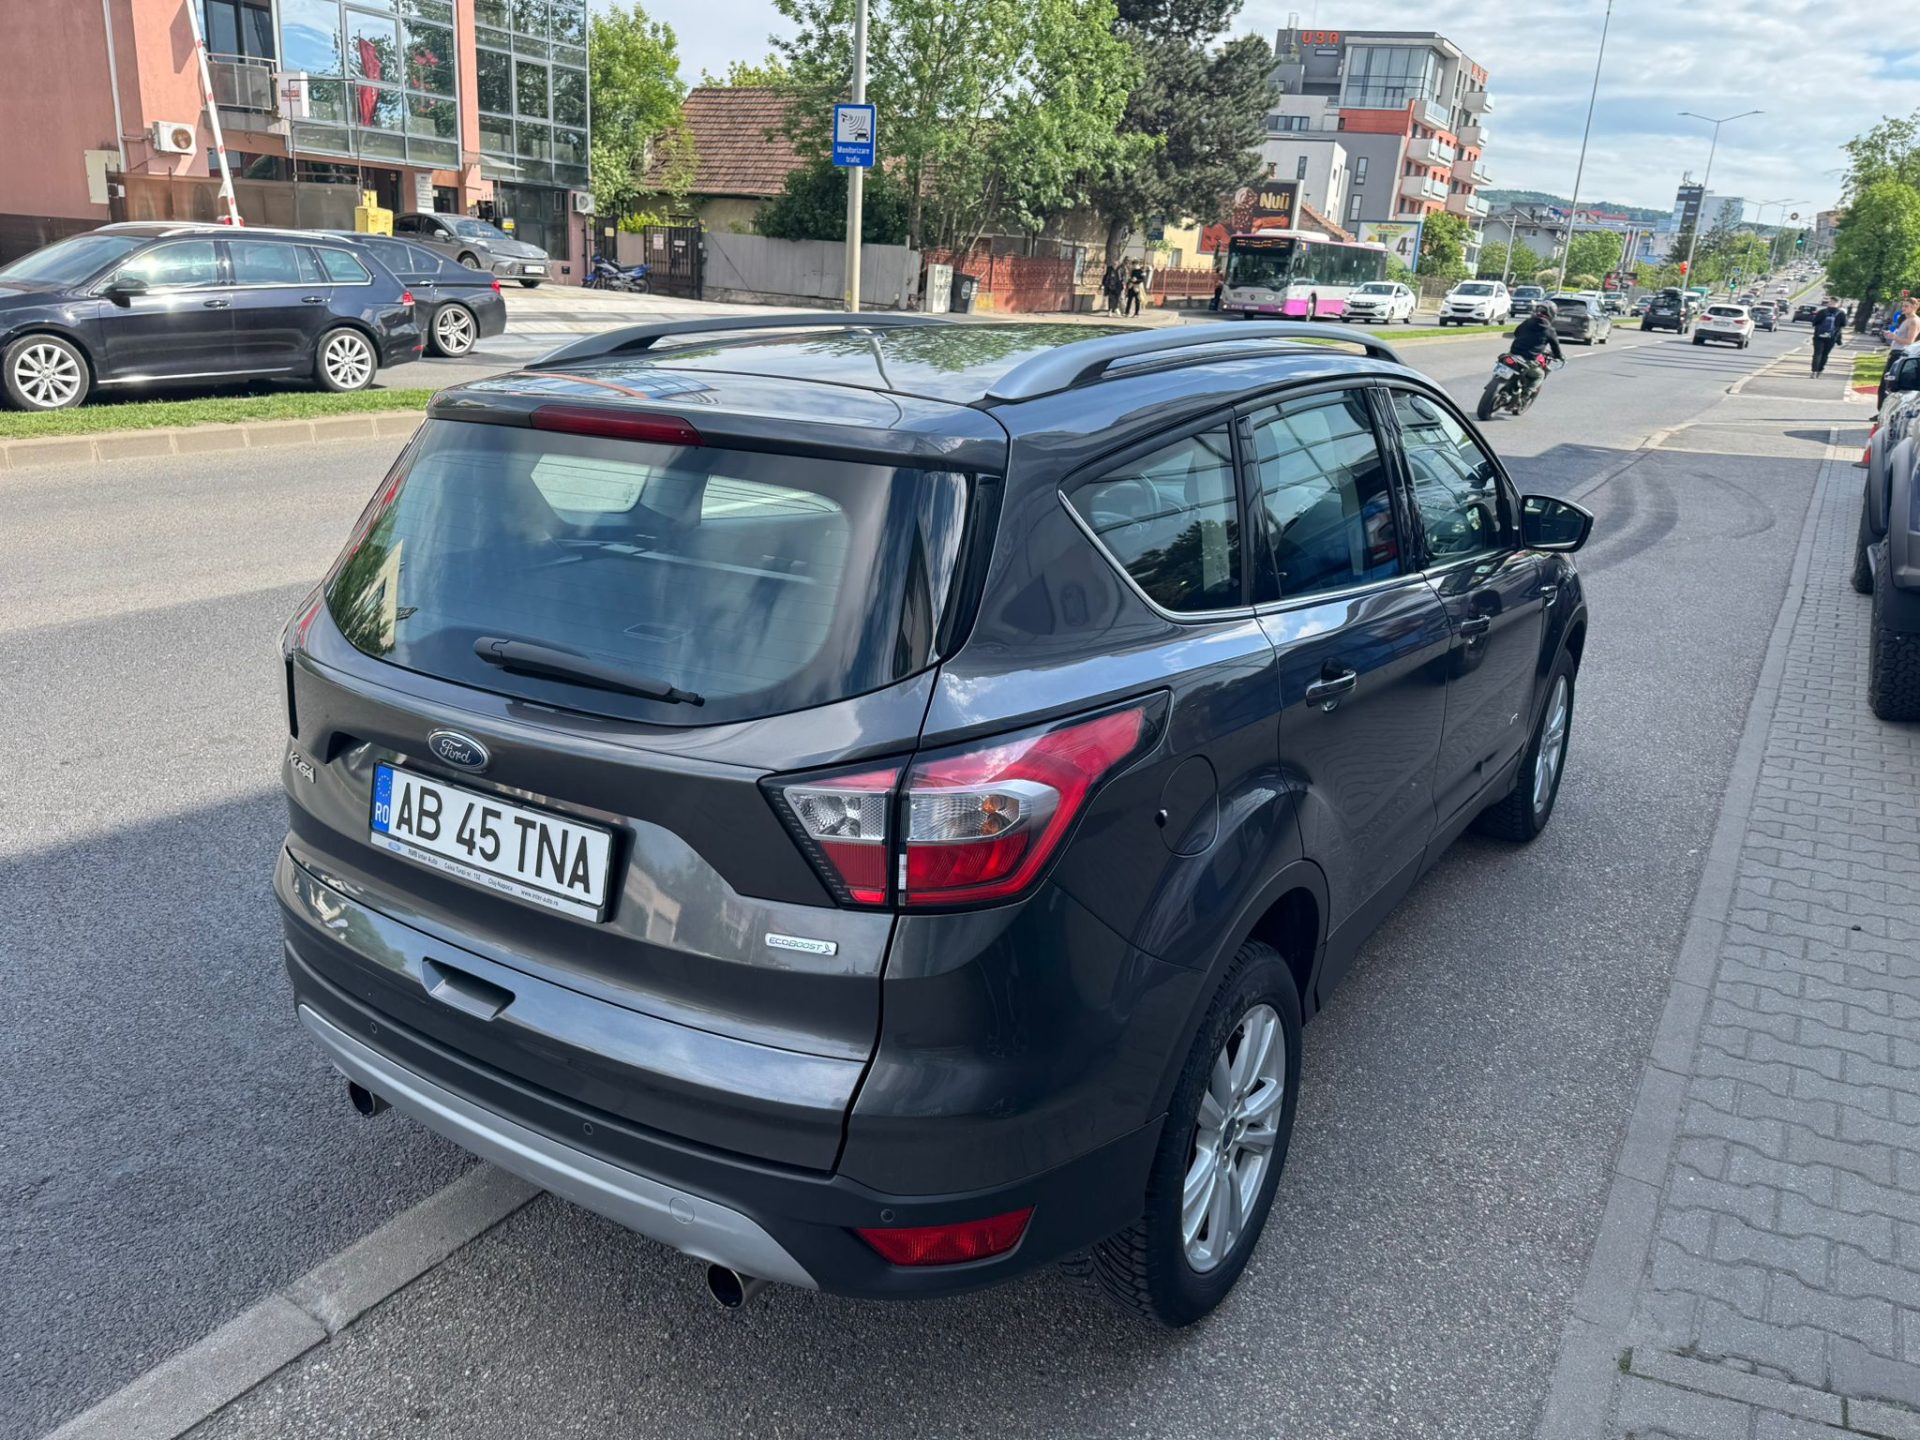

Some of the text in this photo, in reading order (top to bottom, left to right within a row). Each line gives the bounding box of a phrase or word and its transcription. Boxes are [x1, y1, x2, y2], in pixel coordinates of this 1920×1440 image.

[837, 146, 870, 154] Monitorizare
[846, 155, 860, 163] trafic
[1396, 237, 1408, 256] 4
[439, 738, 472, 764] Ford
[375, 801, 390, 824] RO
[396, 782, 591, 894] AB 45 TNA
